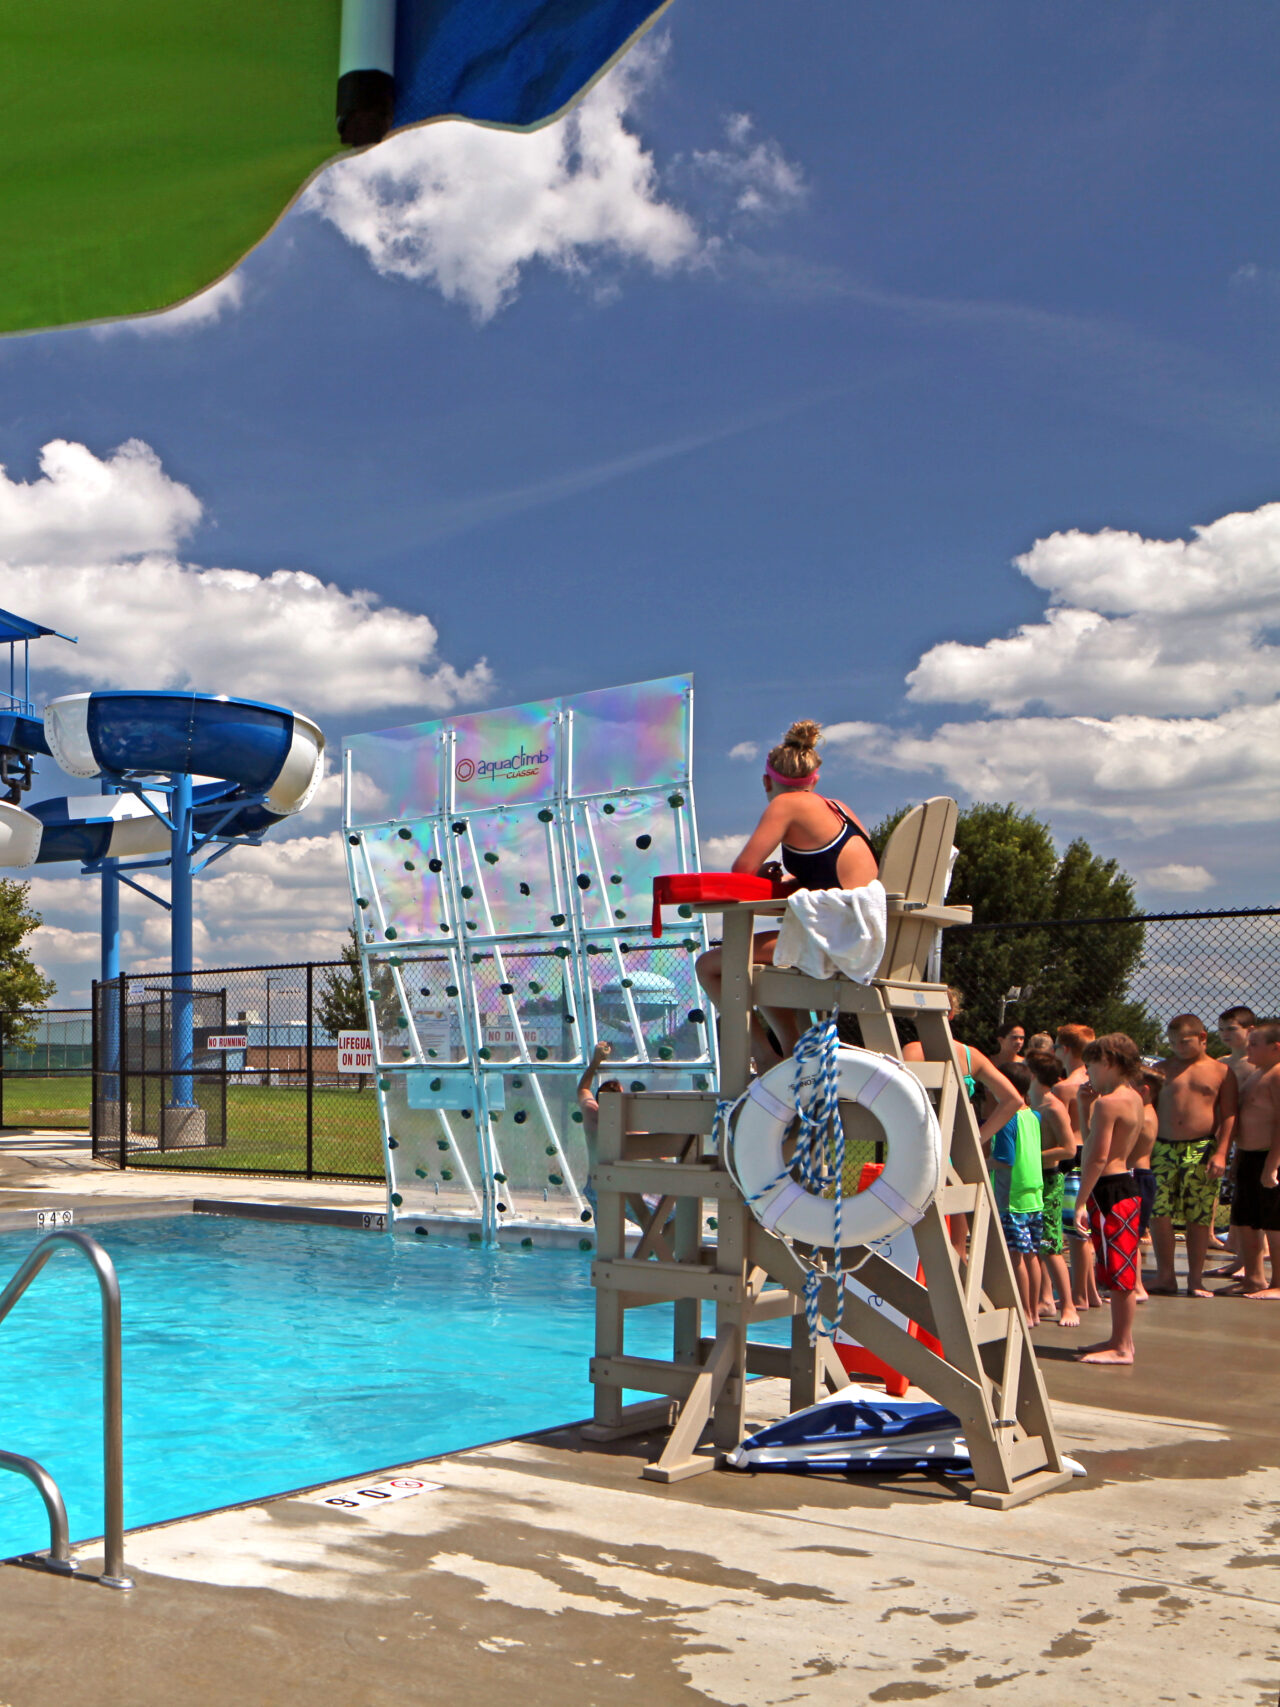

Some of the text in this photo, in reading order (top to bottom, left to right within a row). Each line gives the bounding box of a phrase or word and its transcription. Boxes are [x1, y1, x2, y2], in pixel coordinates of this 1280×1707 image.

[208, 1037, 246, 1047] NO RUNNING
[488, 1031, 537, 1042] NO DING
[338, 1037, 381, 1050] LIFEGUA
[342, 1053, 353, 1066] ON
[38, 1211, 56, 1225] 9 4
[364, 1215, 384, 1229] 9 4
[324, 1498, 360, 1508] 9
